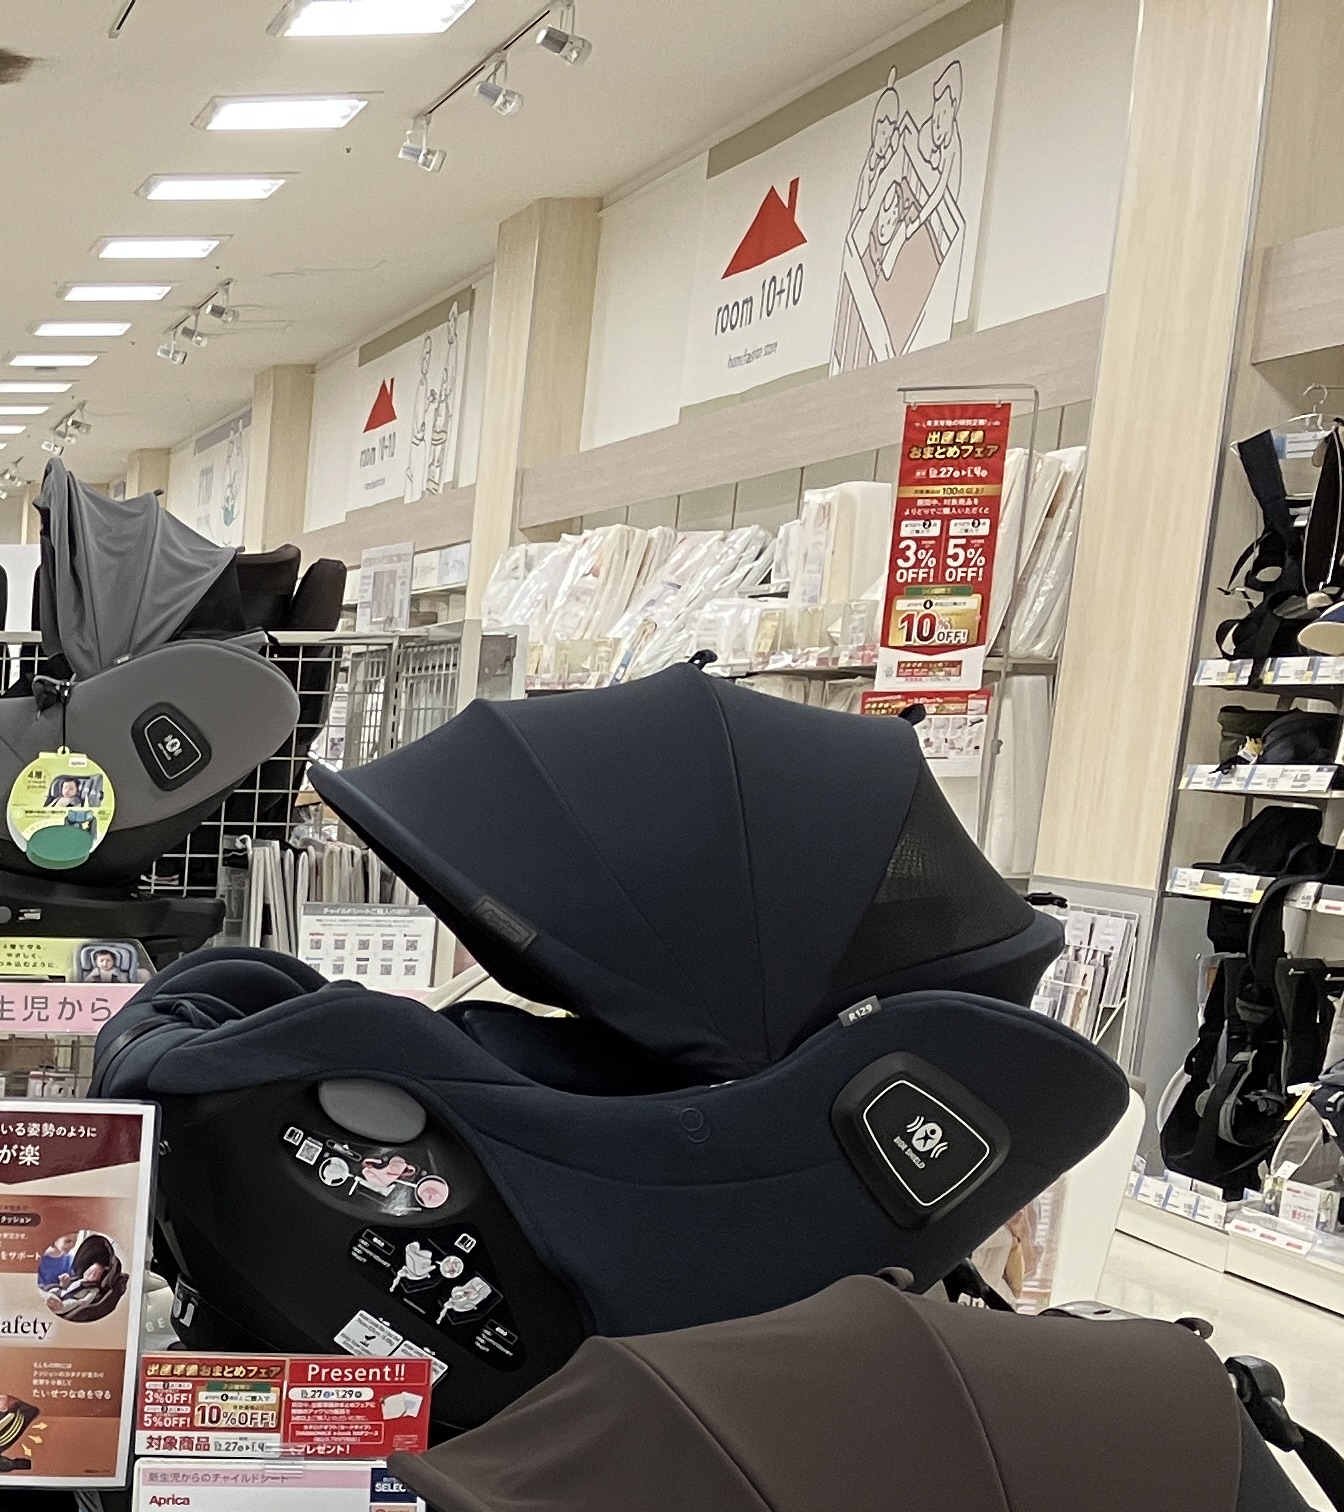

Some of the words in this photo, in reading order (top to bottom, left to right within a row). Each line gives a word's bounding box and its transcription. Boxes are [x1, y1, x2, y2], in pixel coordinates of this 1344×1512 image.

[715, 296, 753, 336] room
[759, 263, 803, 320] 10+10
[909, 445, 998, 460] おまとめフェア
[897, 539, 936, 568] 3%
[946, 539, 985, 567] 5%
[896, 568, 934, 583] OFF!
[946, 567, 983, 582] OFF!
[936, 630, 968, 644] OFF!
[848, 1004, 873, 1022] R129
[307, 1364, 406, 1383] Present!!
[149, 1494, 190, 1508] Aprica
